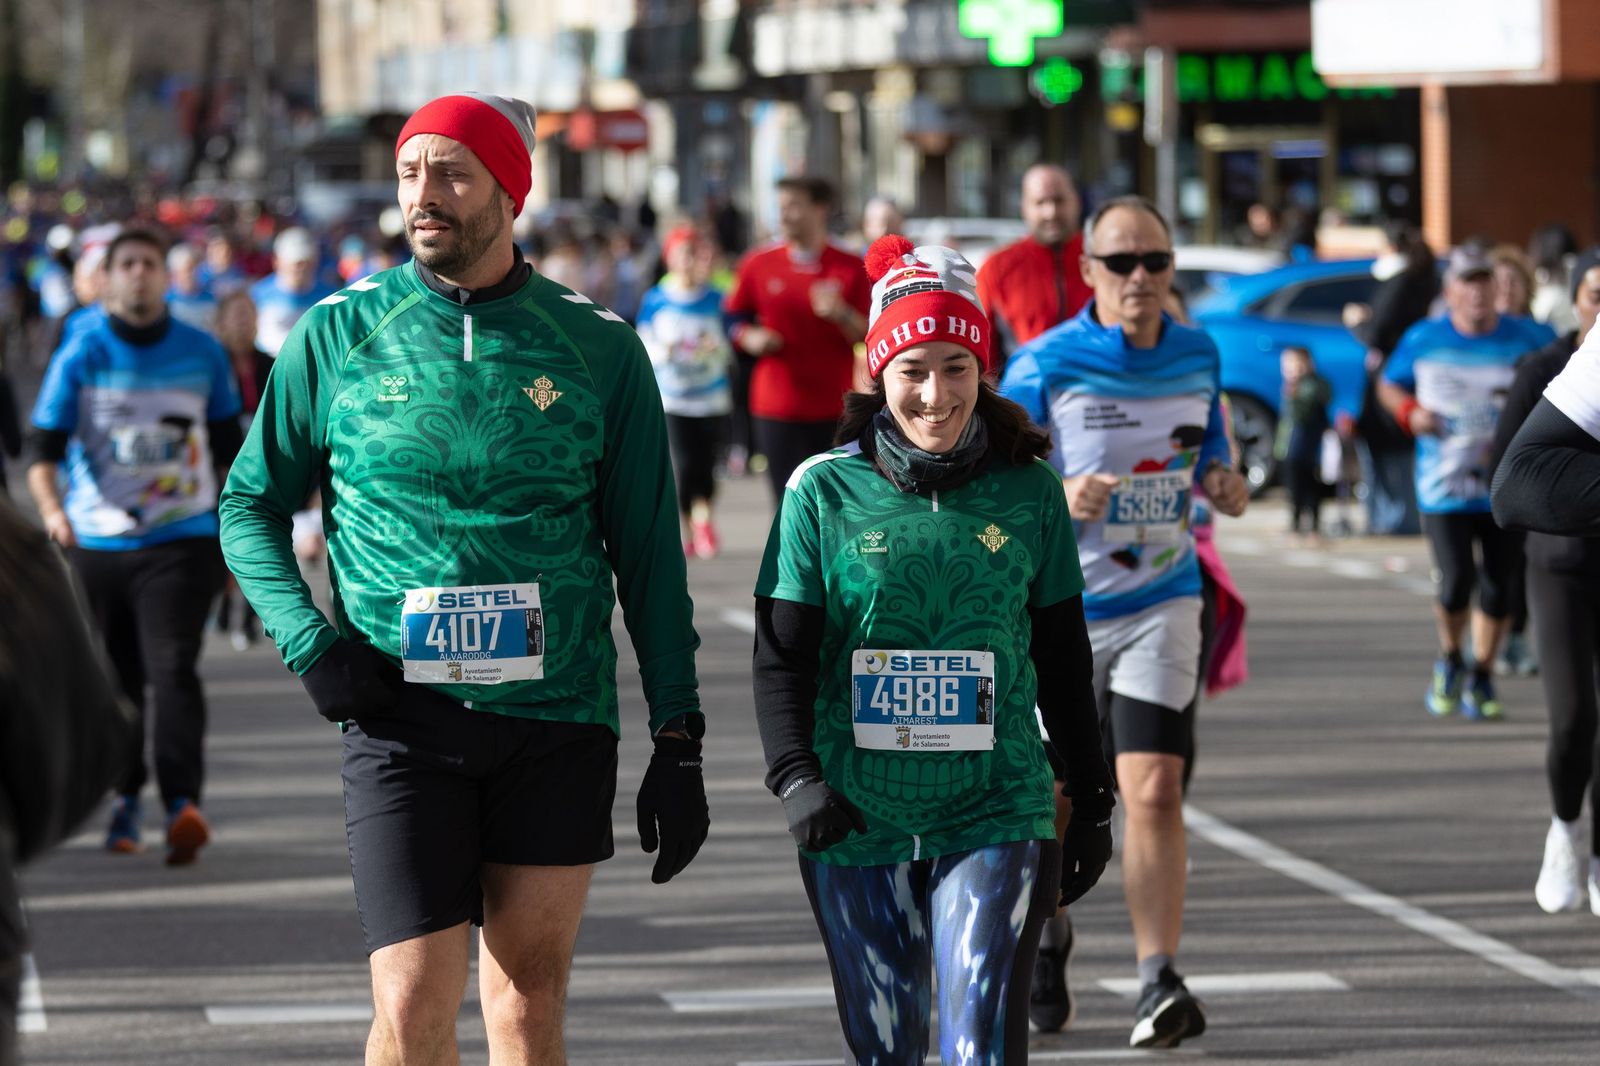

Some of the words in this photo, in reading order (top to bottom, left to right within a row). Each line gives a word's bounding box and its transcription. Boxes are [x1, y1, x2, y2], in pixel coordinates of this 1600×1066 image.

[868, 338, 890, 372] HO
[891, 316, 936, 347] HO
[947, 315, 981, 344] HO
[378, 393, 408, 402] hummel
[1118, 491, 1178, 522] 5362
[861, 545, 887, 553] hummel
[437, 590, 527, 609] SETEL
[425, 611, 503, 653] 4107
[890, 655, 981, 672] SETEL
[870, 676, 959, 717] 4986
[891, 716, 938, 725] AIMAREST
[783, 778, 803, 799] KIPRUN
